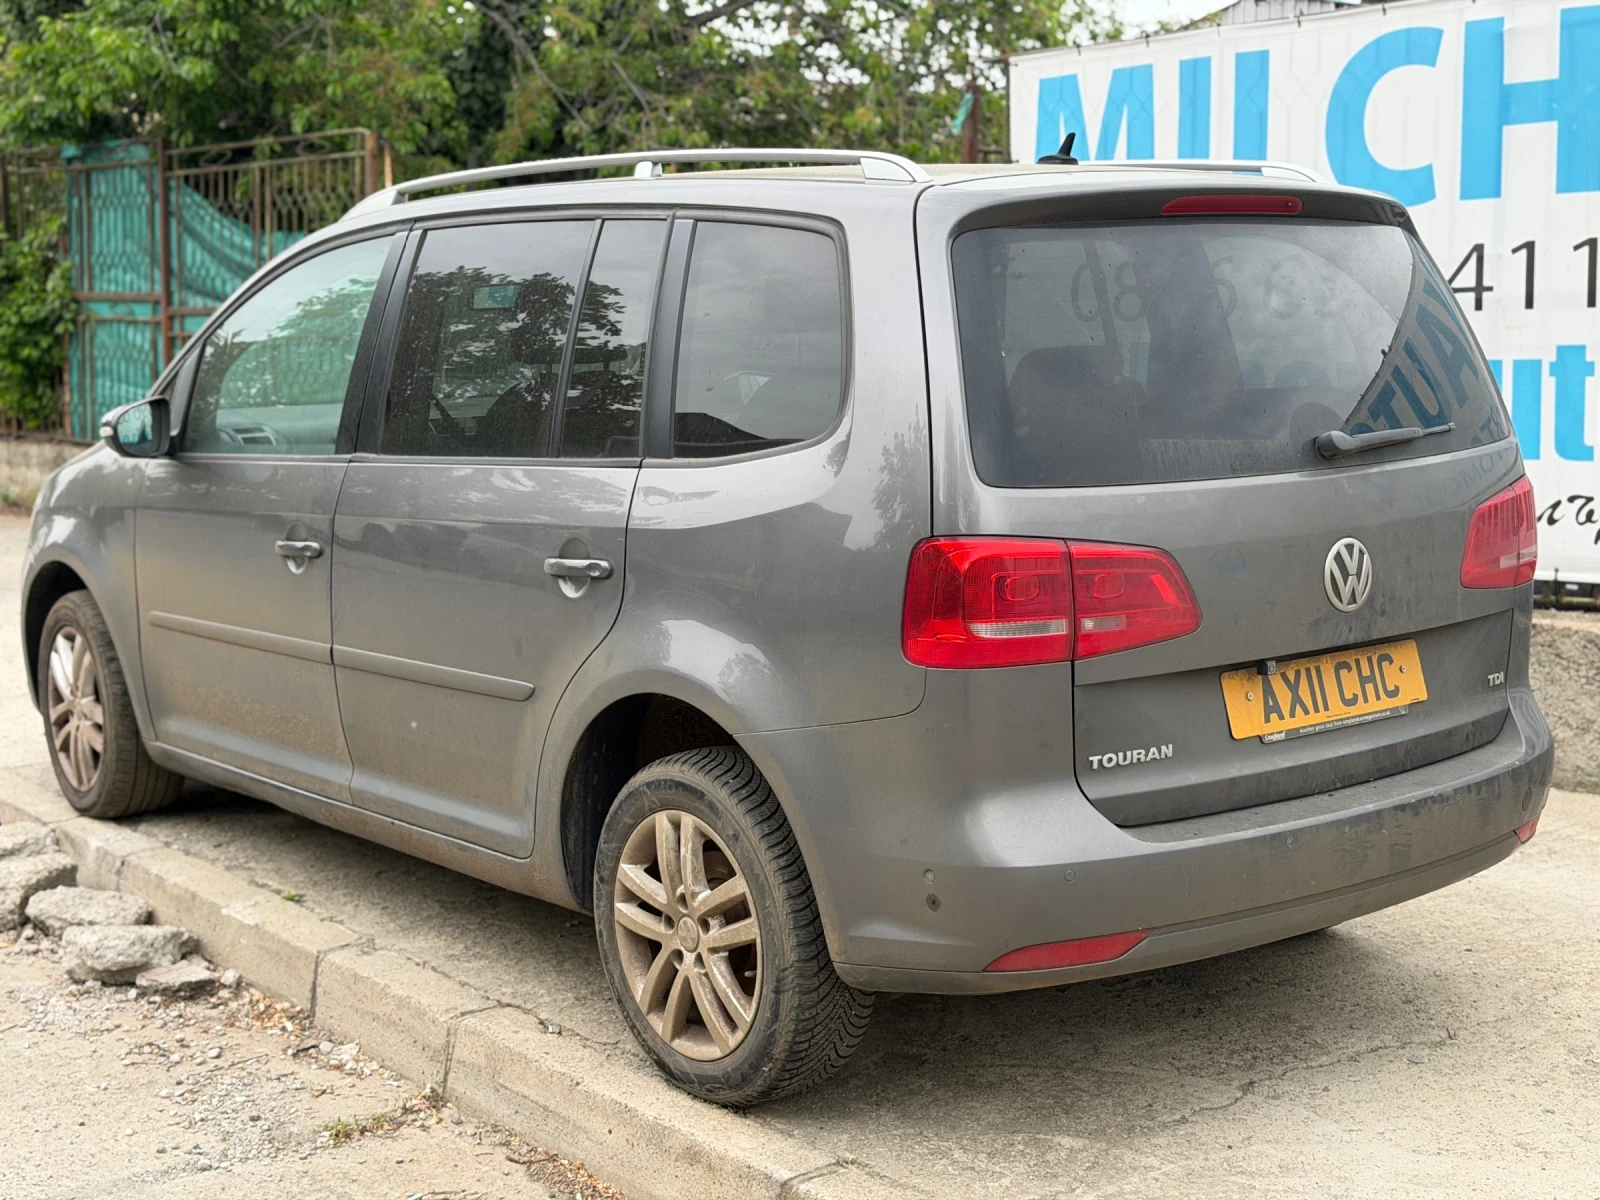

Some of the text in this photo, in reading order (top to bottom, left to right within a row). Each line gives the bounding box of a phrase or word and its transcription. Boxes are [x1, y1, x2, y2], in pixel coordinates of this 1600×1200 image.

[1334, 653, 1400, 708] CHC
[1487, 671, 1504, 687] TDI
[1088, 744, 1173, 769] TOURAN
